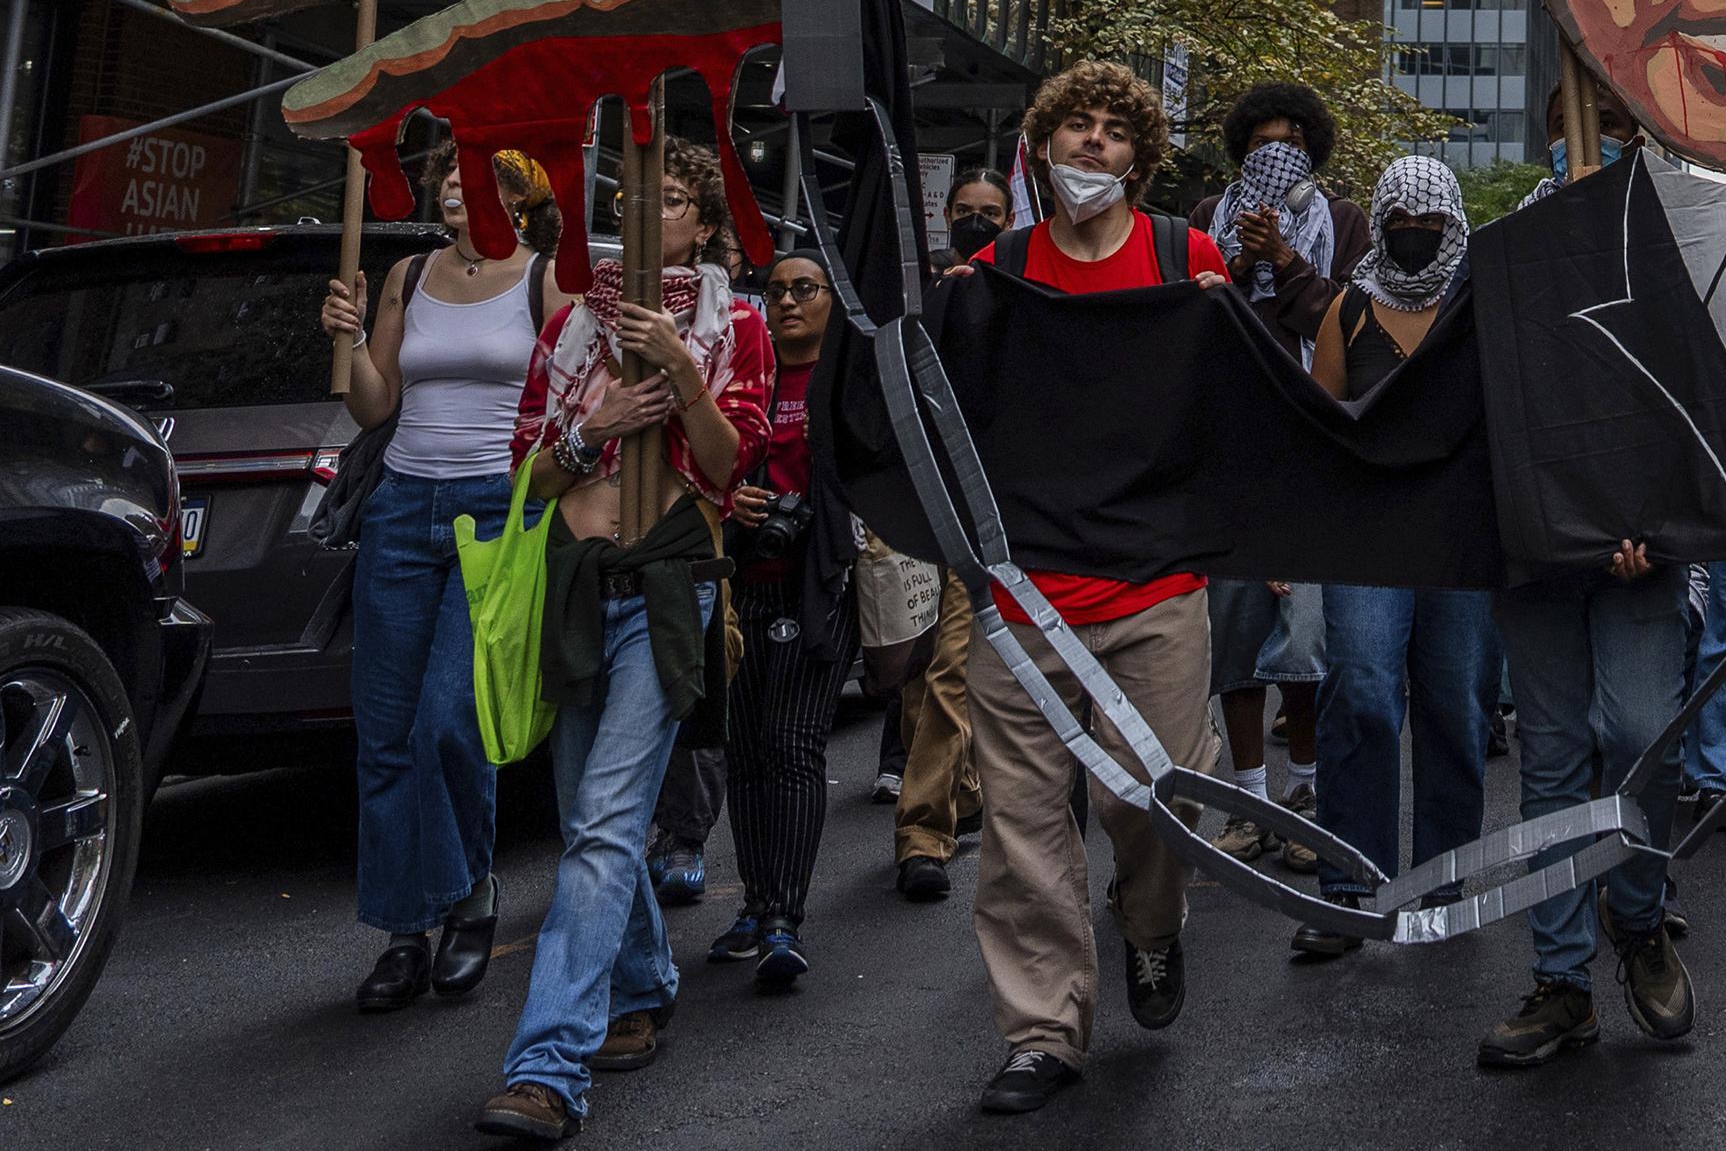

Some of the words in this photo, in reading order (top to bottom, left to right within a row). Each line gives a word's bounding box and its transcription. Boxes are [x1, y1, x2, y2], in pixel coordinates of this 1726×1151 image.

[126, 136, 206, 179] #STOP
[919, 157, 949, 165] uthorized
[121, 178, 200, 222] ASIAN
[904, 578, 911, 592] IS
[912, 572, 933, 588] FULL
[907, 593, 919, 610] OF
